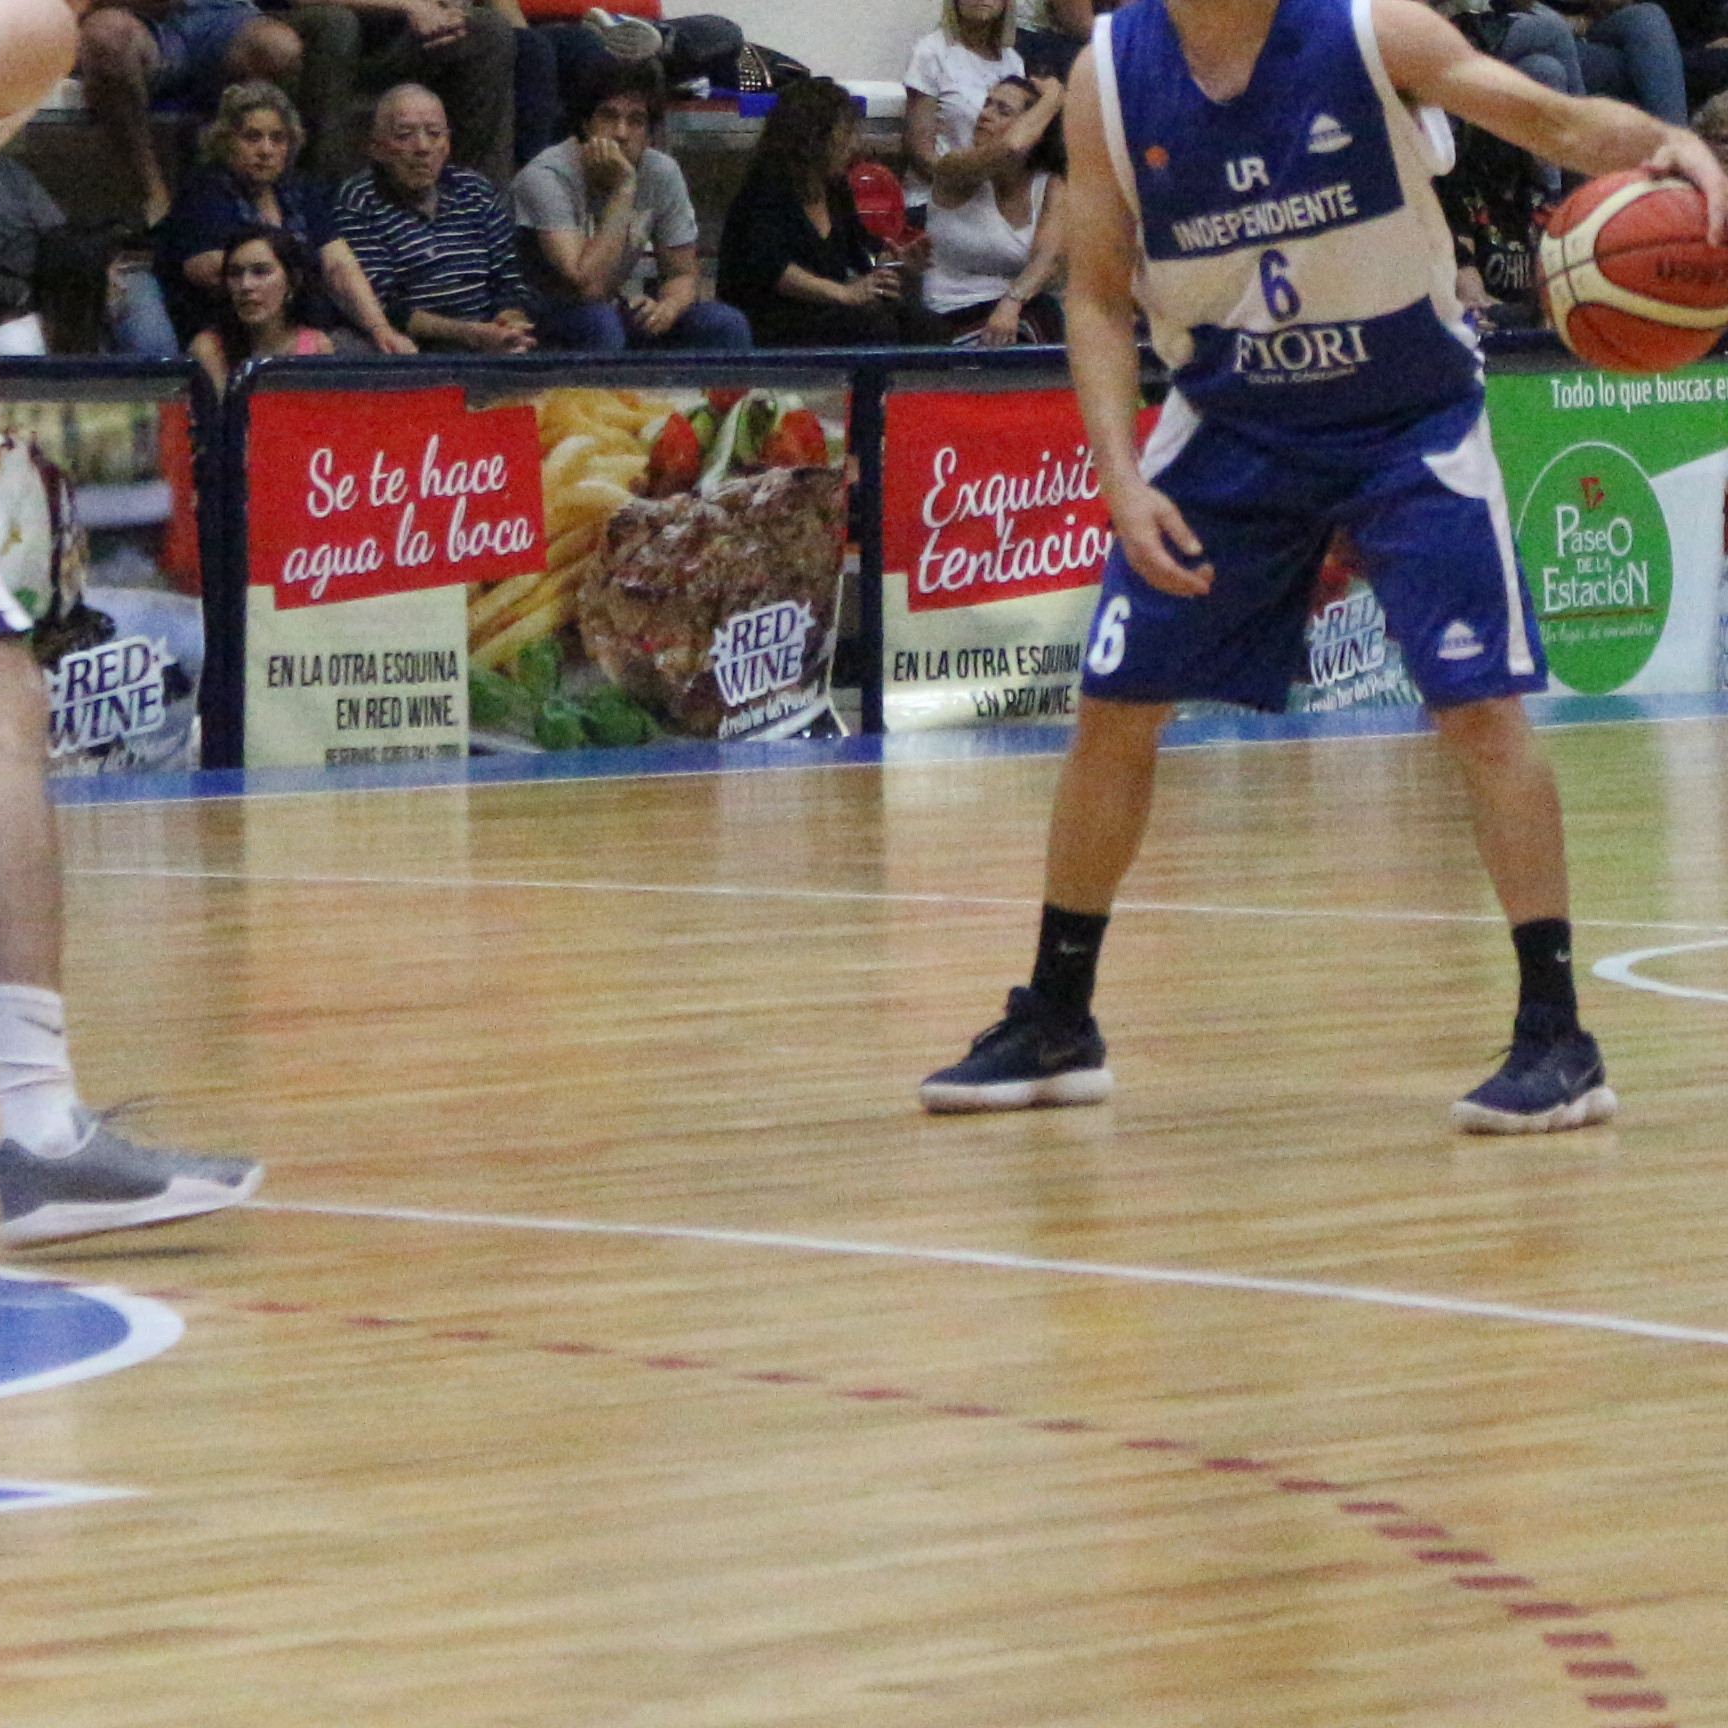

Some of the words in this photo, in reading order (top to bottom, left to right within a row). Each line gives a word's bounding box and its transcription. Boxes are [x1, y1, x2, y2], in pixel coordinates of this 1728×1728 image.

[1173, 183, 1358, 251] INDEPENDIENTE
[1260, 249, 1301, 322] 6
[1233, 325, 1371, 372] FIORI
[1551, 376, 1594, 409] Todo
[1598, 374, 1615, 407] lo
[1620, 382, 1651, 412] que
[1656, 373, 1711, 403] buscas
[308, 449, 358, 518] Se
[370, 452, 408, 507] te
[421, 435, 507, 497] hace
[923, 445, 1100, 537] Exquisit
[283, 539, 383, 599] agua
[395, 508, 435, 567] la
[446, 497, 535, 562] boca
[732, 607, 797, 656] RED
[1087, 595, 1131, 674] 6
[64, 641, 153, 703] RED
[268, 655, 294, 688] EN
[300, 655, 322, 686] LA
[329, 653, 377, 686] OTRA
[383, 650, 458, 684] ESQUINA
[720, 643, 800, 700] WINE
[894, 651, 919, 681] EN
[926, 651, 949, 680] LA
[956, 647, 1010, 678] OTRA
[1016, 642, 1080, 675] ESQUINA
[50, 686, 162, 754] WINE
[337, 698, 360, 730] EN
[366, 697, 401, 728] RED
[972, 689, 999, 717] EN
[1003, 687, 1035, 716] RED
